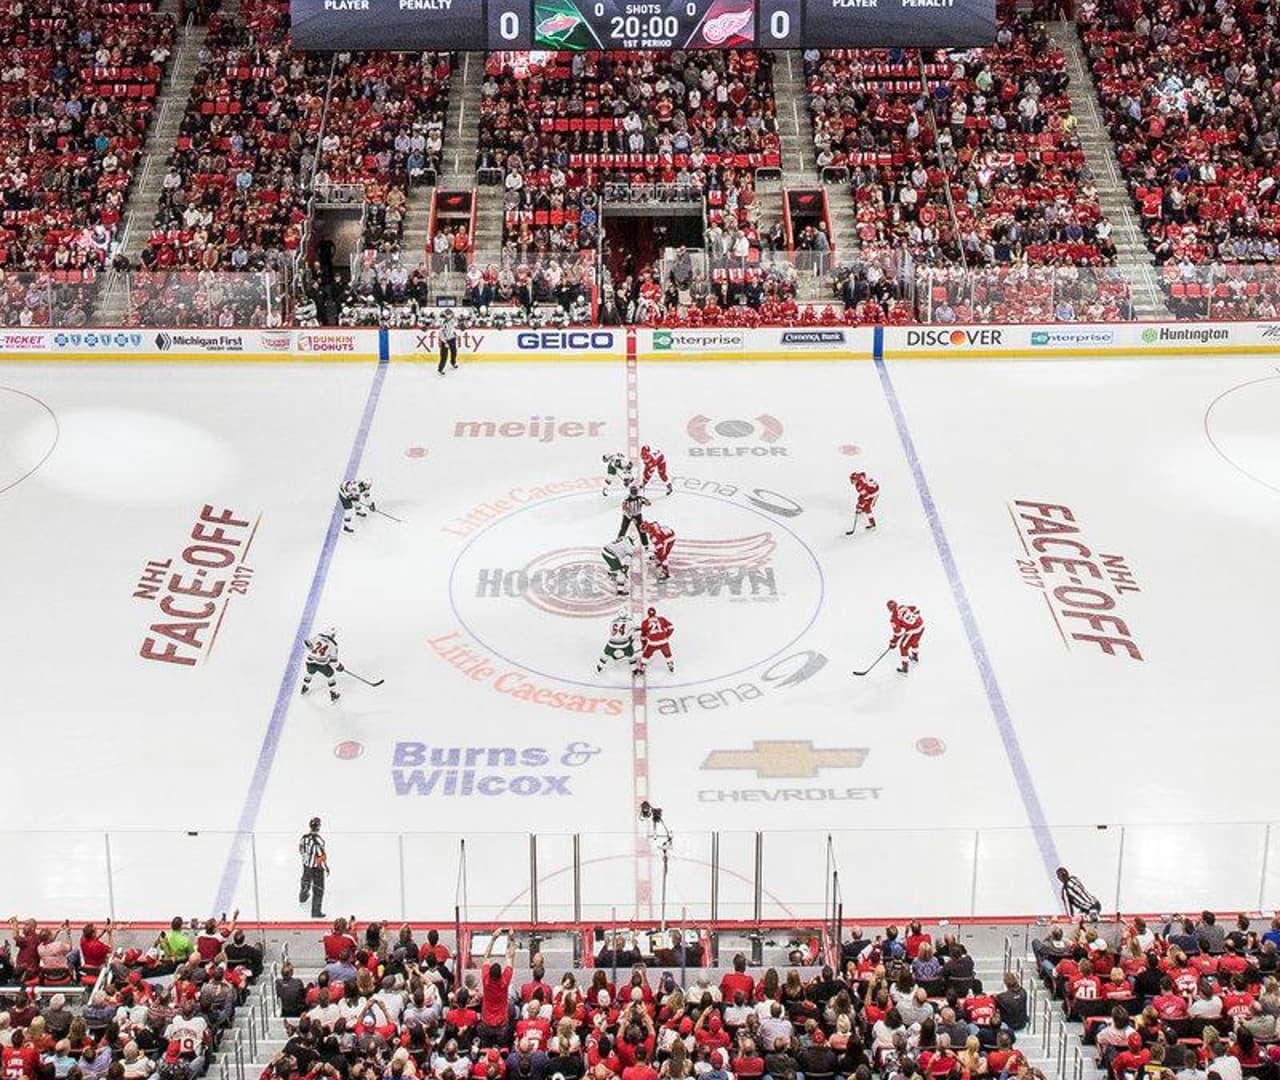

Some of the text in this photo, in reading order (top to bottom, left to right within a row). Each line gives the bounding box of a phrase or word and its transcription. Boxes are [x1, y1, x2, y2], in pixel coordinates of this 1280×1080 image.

[324, 0, 452, 10] PLAYER PENALTY
[594, 3, 696, 16] 0 SHOTS 0
[500, 12, 520, 40] 0
[610, 16, 679, 39] 20:00
[770, 10, 790, 39] 0
[642, 40, 672, 48] PERIOD
[173, 335, 243, 347] Michigan First
[312, 343, 354, 351] DONUTS
[517, 332, 614, 350] GEICO
[1159, 327, 1229, 344] Huntington
[453, 416, 608, 444] meijer
[687, 446, 789, 458] BELFOR
[132, 557, 173, 601] NHL
[228, 565, 255, 596] 2017
[1098, 552, 1141, 595] NHL
[427, 631, 623, 717] Little Caesars
[657, 680, 765, 717] arena
[390, 740, 550, 768] Burns
[390, 768, 575, 799] Wilcox
[696, 786, 884, 804] CHEVROLET
